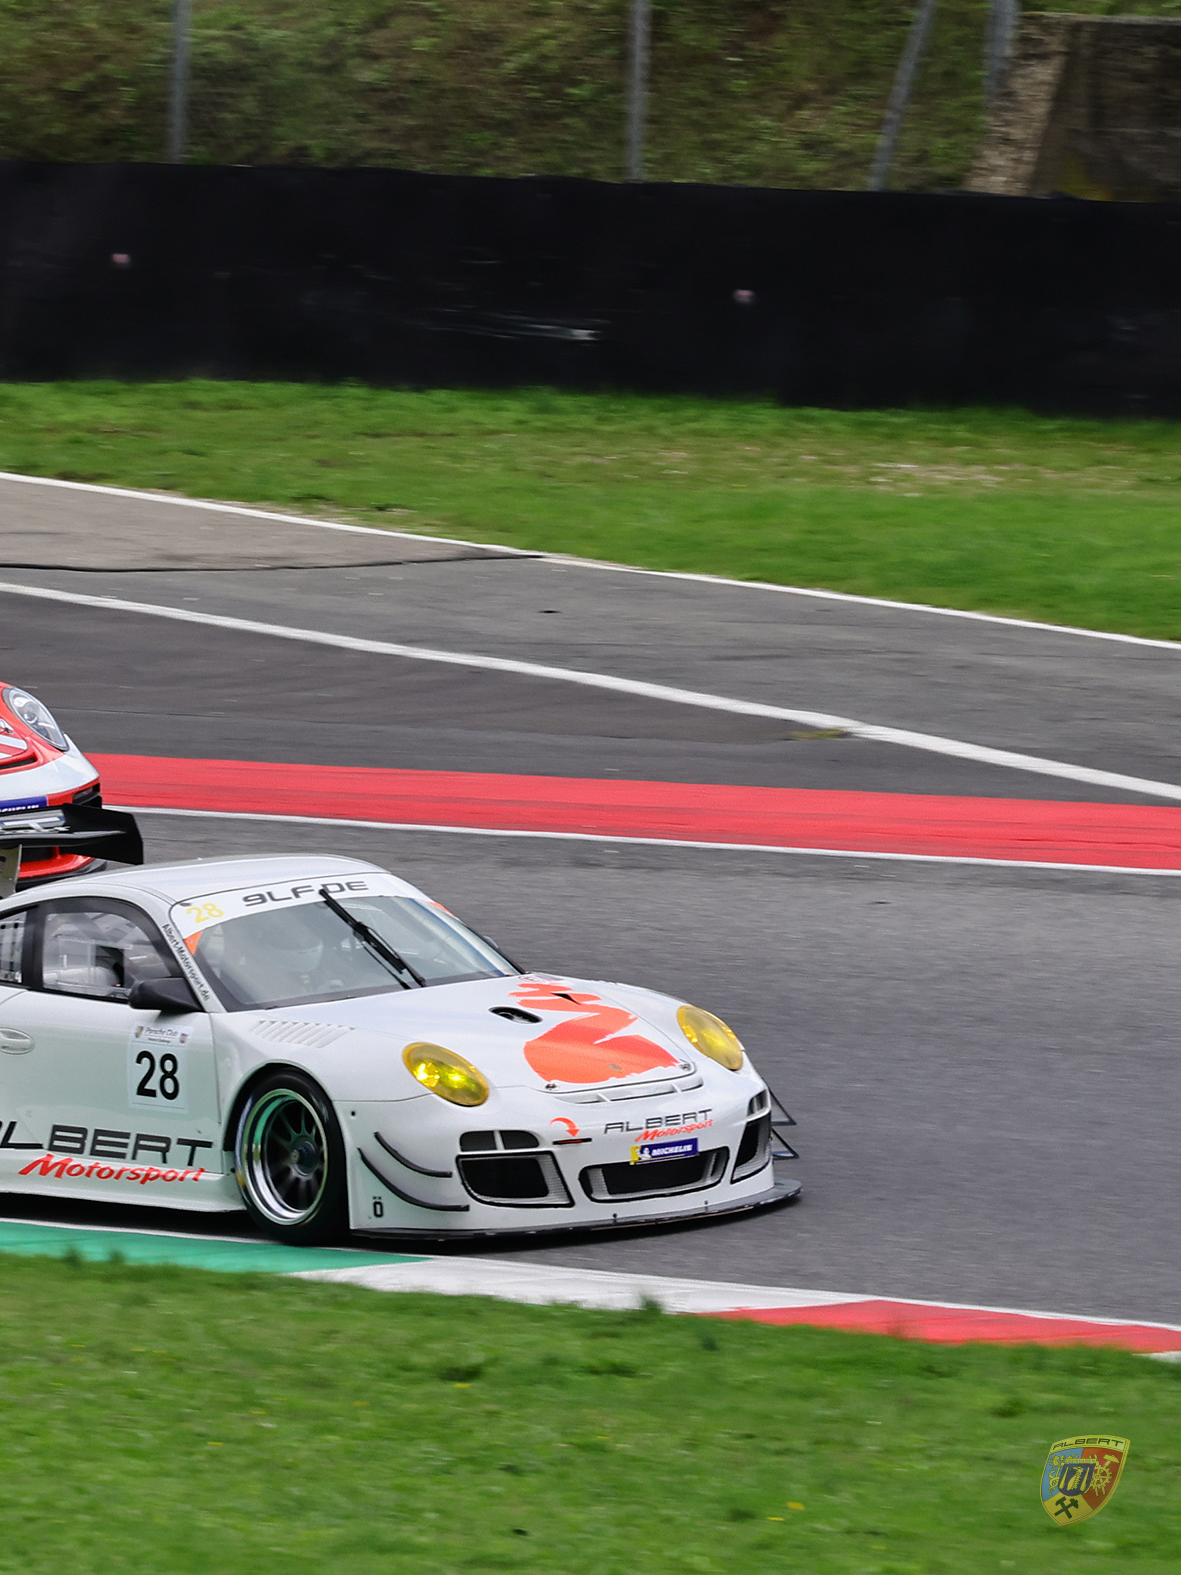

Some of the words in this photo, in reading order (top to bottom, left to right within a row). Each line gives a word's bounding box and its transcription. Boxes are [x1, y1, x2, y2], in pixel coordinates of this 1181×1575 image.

[186, 902, 224, 923] 28
[135, 1050, 180, 1101] 28
[604, 1109, 712, 1134] ALBERT
[634, 1119, 713, 1142] Motorsport
[651, 1144, 693, 1156] MICHELIN
[18, 1153, 209, 1185] Motorsport
[373, 1196, 384, 1218] Ö
